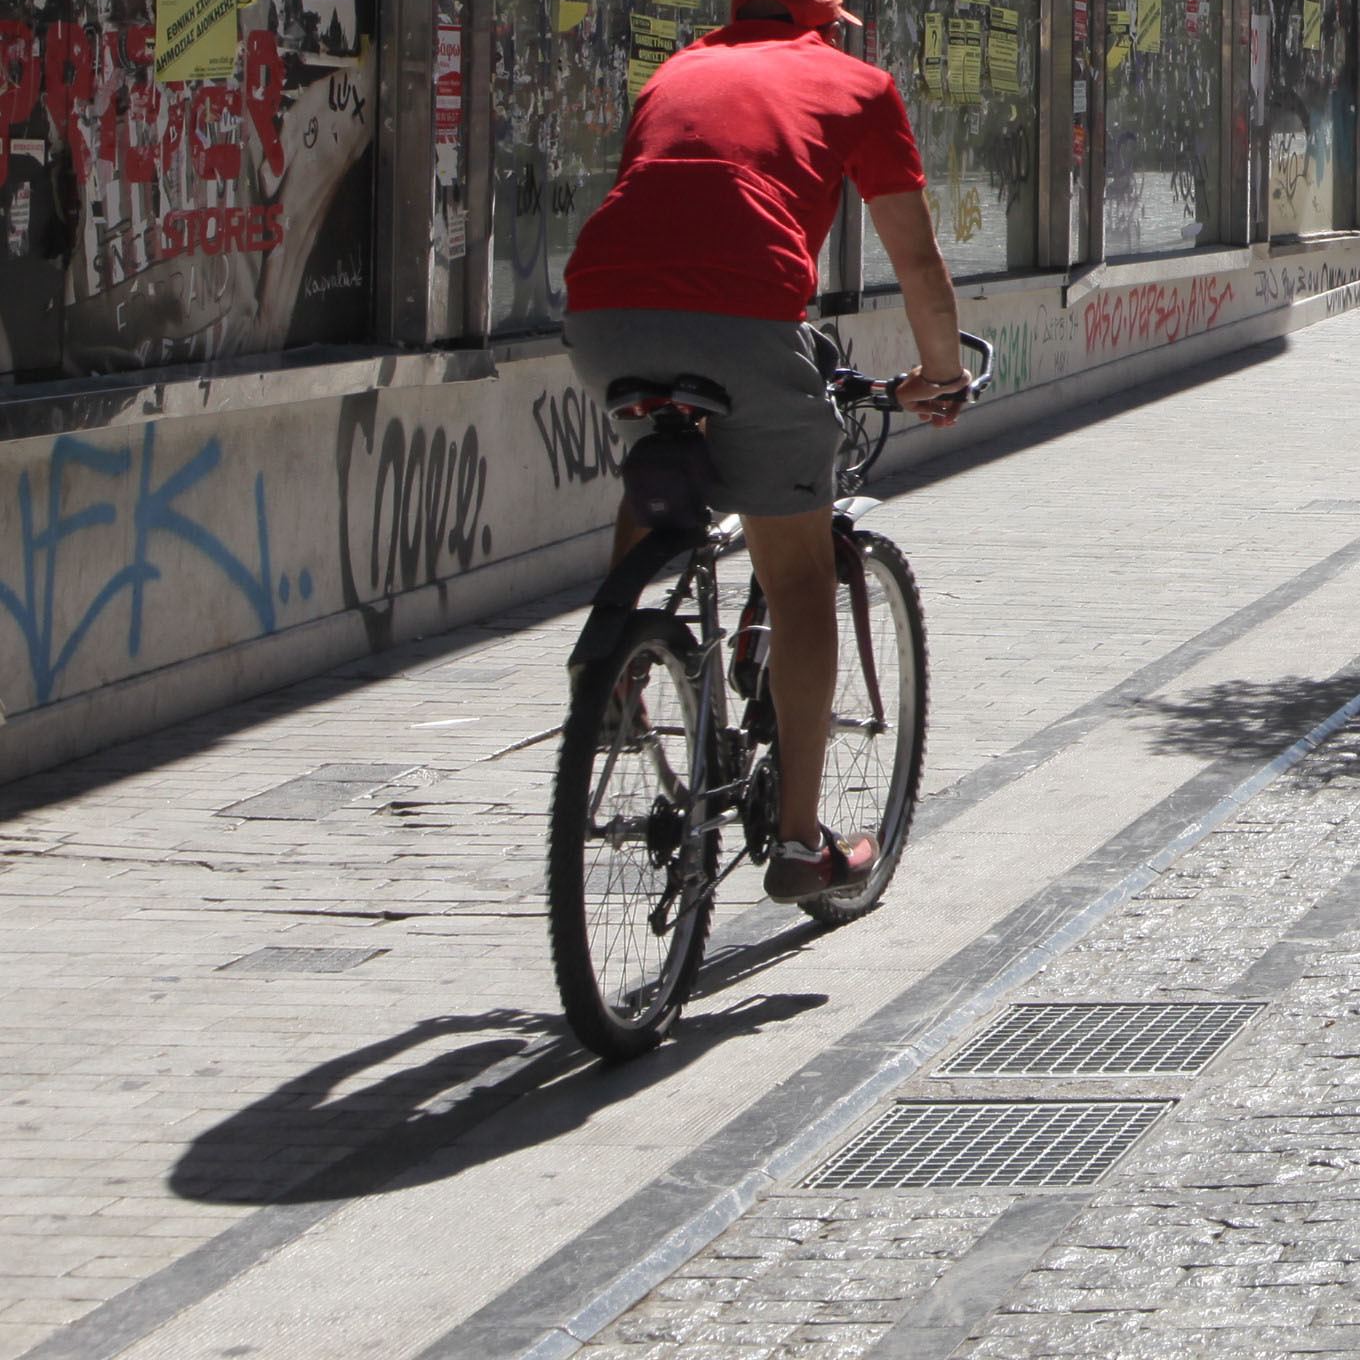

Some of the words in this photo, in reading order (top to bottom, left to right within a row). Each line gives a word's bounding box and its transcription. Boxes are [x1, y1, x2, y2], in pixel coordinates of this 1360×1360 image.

[167, 7, 197, 41] ΕΘΝΙΚΗ
[156, 29, 196, 73] ΔΗΜΟΣΙΑΣ
[162, 204, 285, 260] STORES
